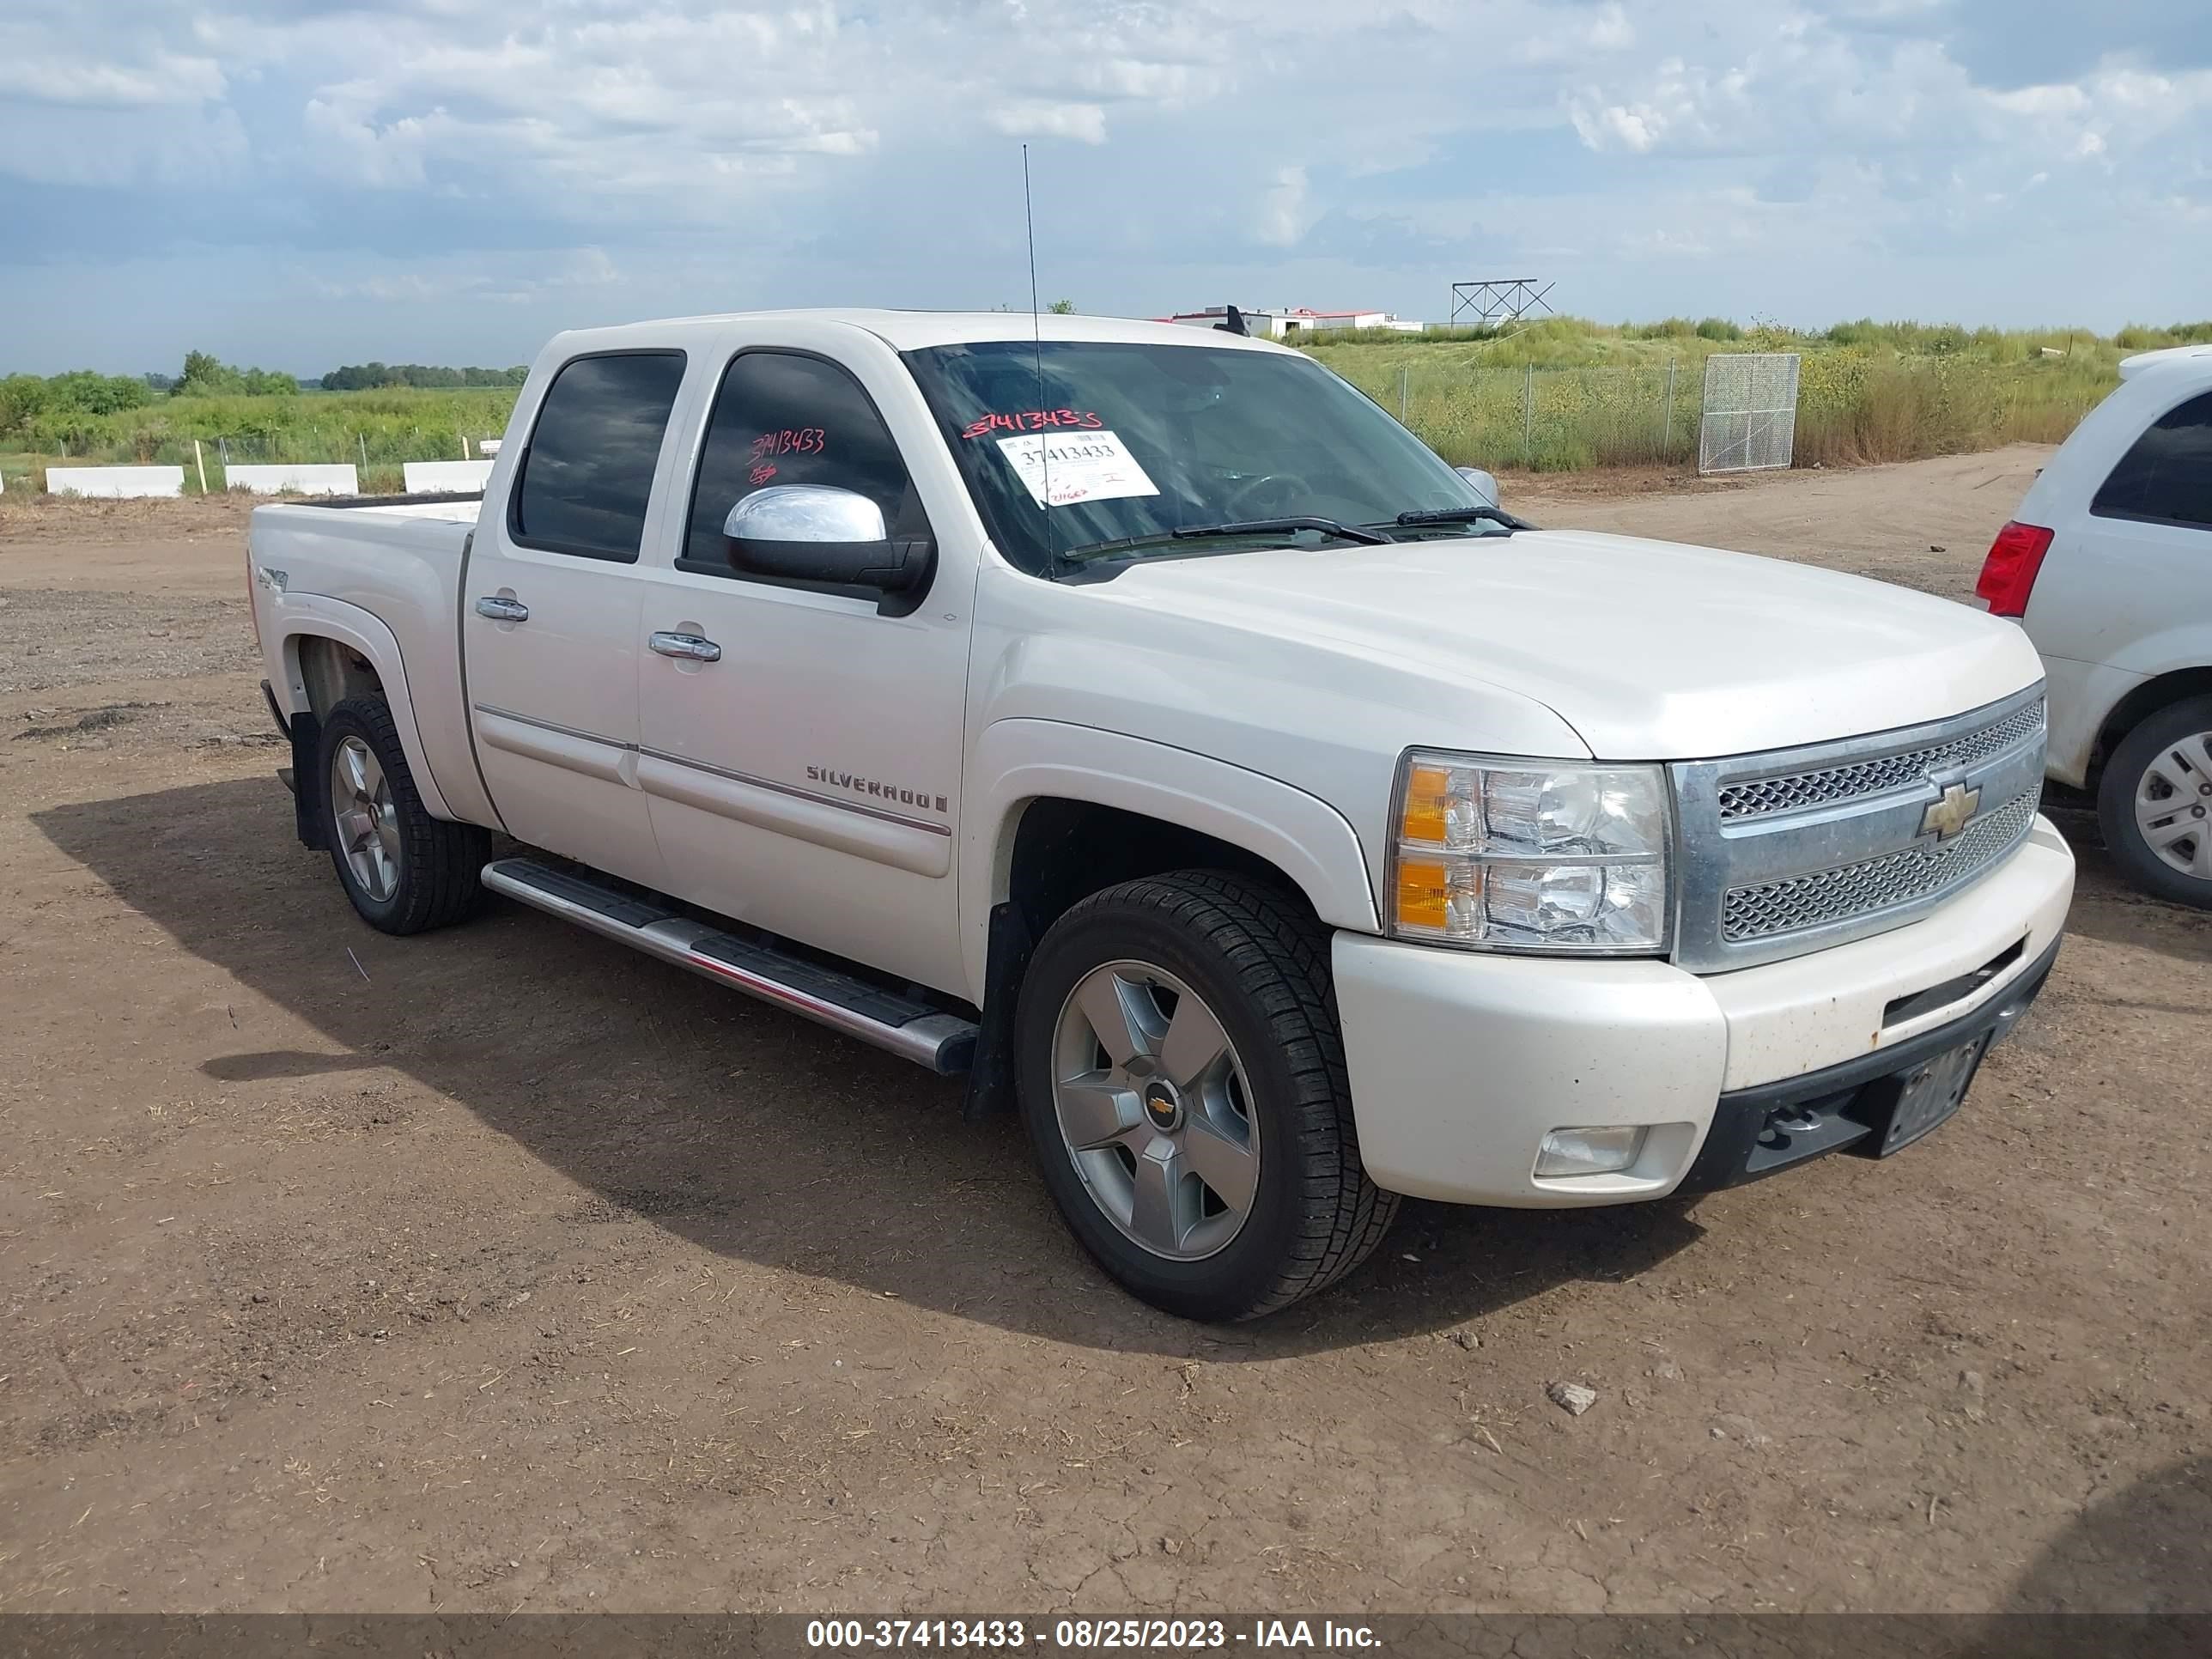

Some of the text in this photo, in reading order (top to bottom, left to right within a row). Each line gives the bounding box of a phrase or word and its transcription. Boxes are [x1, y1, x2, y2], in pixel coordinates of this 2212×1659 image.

[745, 428, 825, 466] 37413433
[1020, 445, 1115, 465] 37413433
[806, 765, 930, 809] SILVERADO
